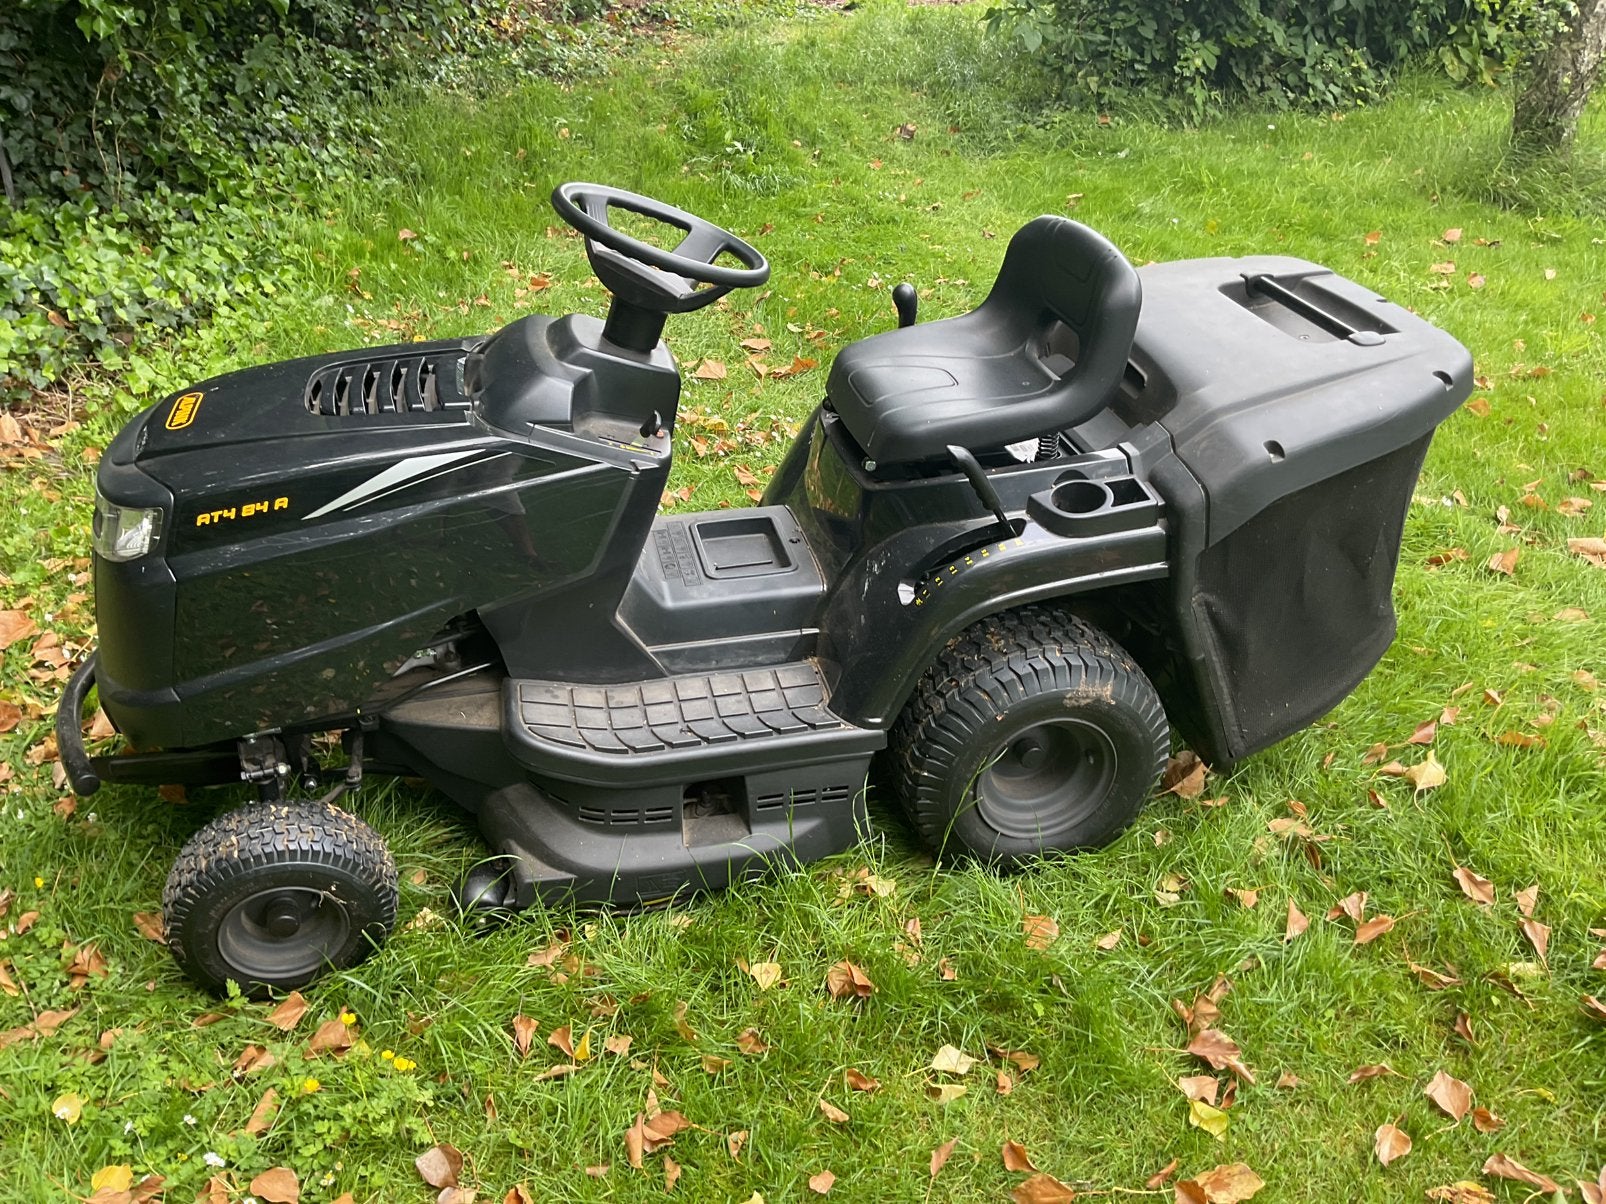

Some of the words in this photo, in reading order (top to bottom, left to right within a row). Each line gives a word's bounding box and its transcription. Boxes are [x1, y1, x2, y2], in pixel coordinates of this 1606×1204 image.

[196, 507, 236, 526] AT4
[241, 500, 269, 517] 84
[274, 497, 289, 510] A
